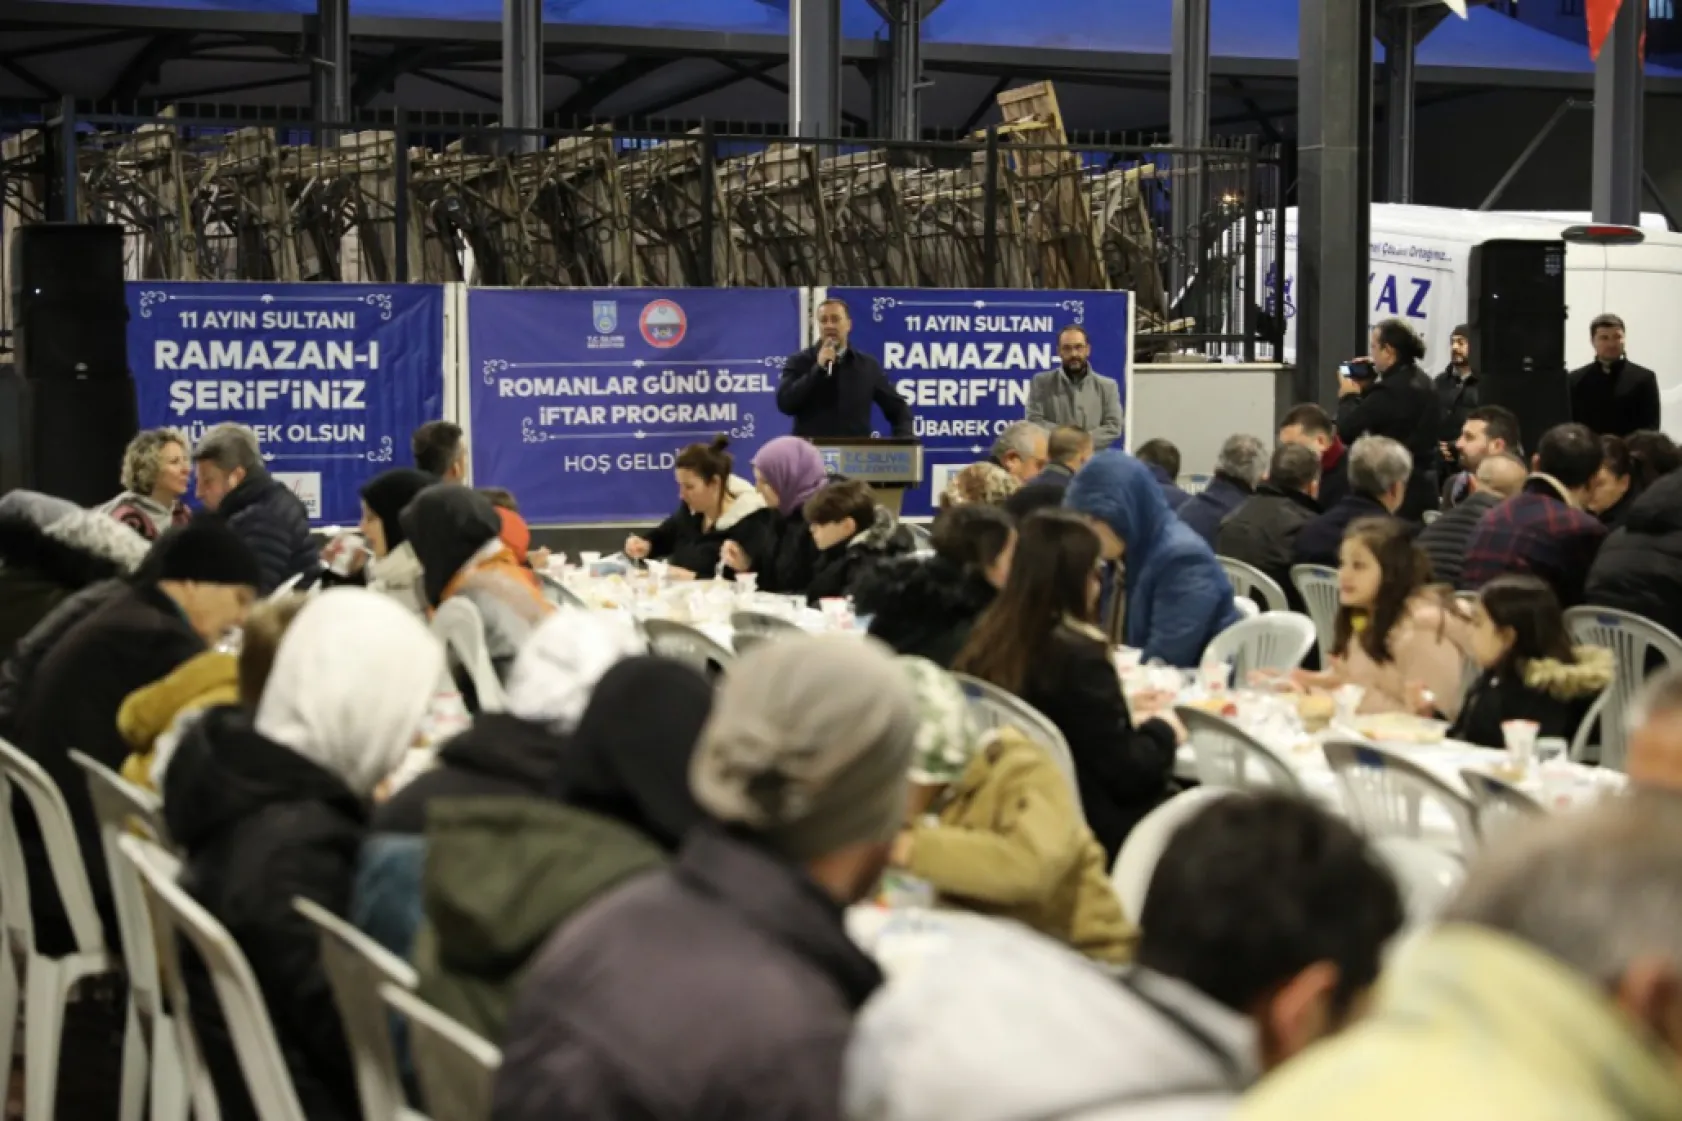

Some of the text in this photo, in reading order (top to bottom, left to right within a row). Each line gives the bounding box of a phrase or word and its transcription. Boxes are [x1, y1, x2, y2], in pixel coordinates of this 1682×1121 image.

[1369, 272, 1432, 319] AZ
[179, 311, 355, 329] 11 AYIN SULTANI
[905, 316, 1053, 332] 11 AYIN SULTANI
[155, 340, 379, 370] RAMAZAN-I
[883, 341, 1062, 370] RAMAZAN-
[498, 368, 775, 397] ROMANLAR GÜNÜ ÖZEL
[611, 403, 738, 424] PROGRAMI
[287, 424, 366, 442] OLSUN
[911, 415, 990, 437] ÜBAREK
[564, 450, 680, 474] HOŞ GELD
